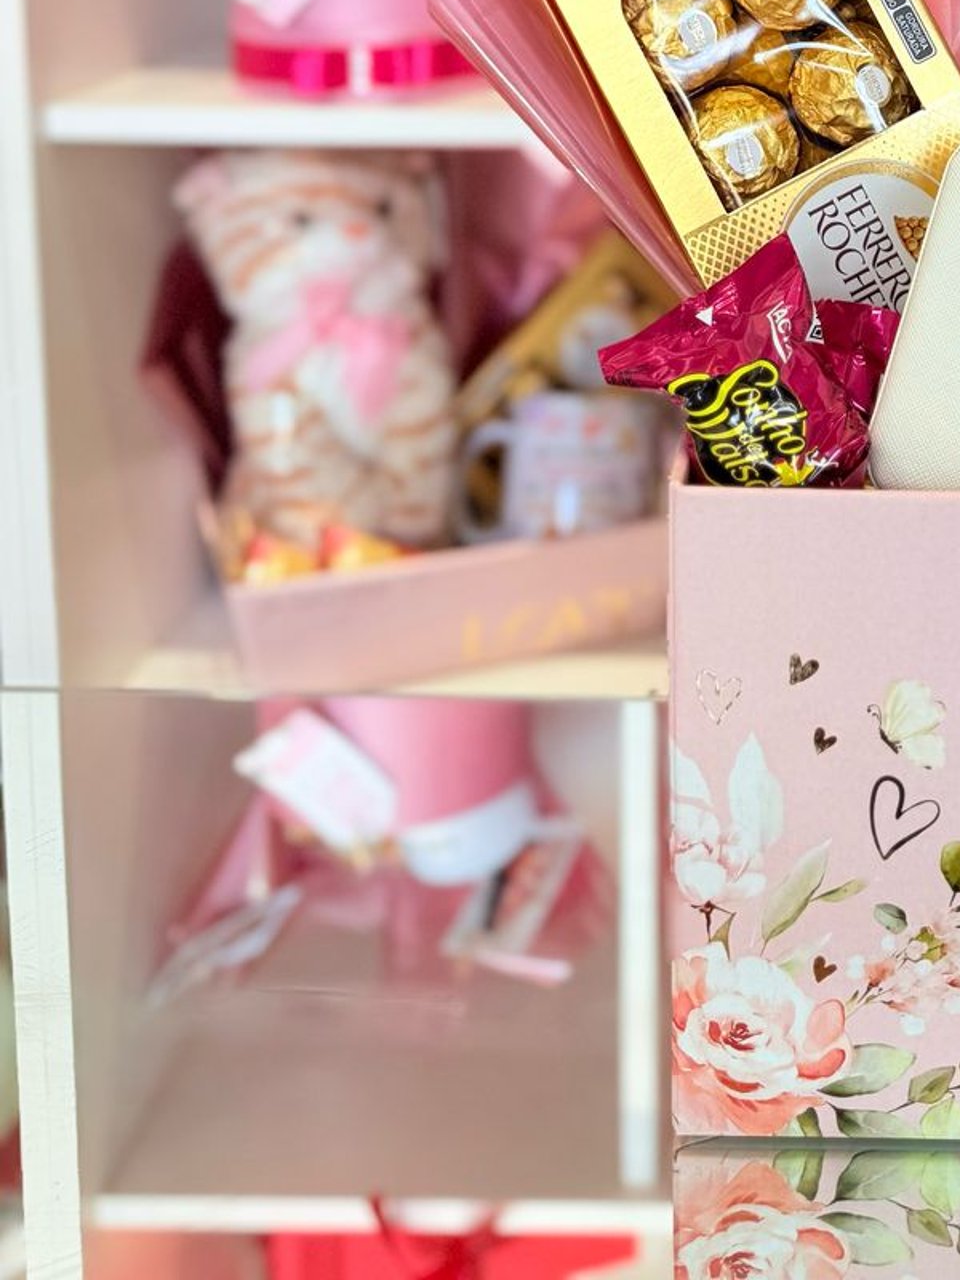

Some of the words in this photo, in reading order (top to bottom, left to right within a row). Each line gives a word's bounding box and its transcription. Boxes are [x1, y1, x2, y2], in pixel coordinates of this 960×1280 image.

[895, 14, 921, 56] SATURADA
[904, 12, 928, 50] GORDURA
[808, 199, 890, 310] ROCHE
